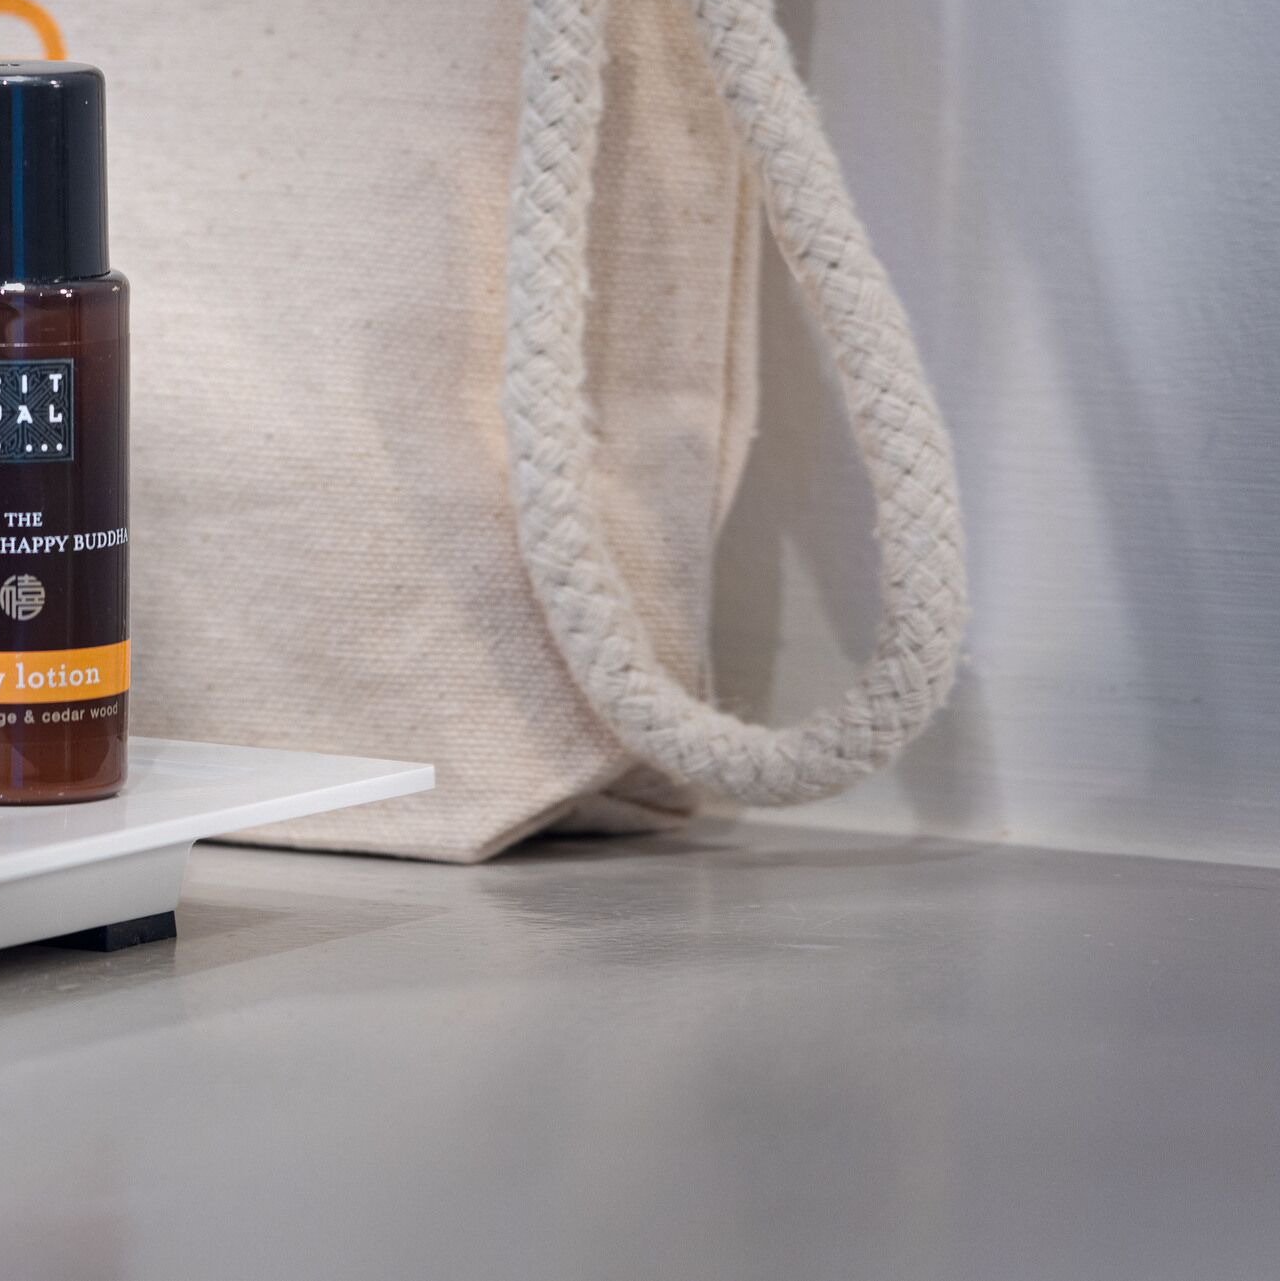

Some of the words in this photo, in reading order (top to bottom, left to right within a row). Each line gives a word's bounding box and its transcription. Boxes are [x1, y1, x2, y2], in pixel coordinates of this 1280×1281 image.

[4, 512, 42, 527] THE
[0, 536, 69, 554] HAPPY
[73, 528, 128, 551] BUDDHA
[16, 663, 100, 689] lotion
[24, 711, 35, 723] &
[42, 708, 84, 723] cedar
[90, 701, 118, 718] wood
